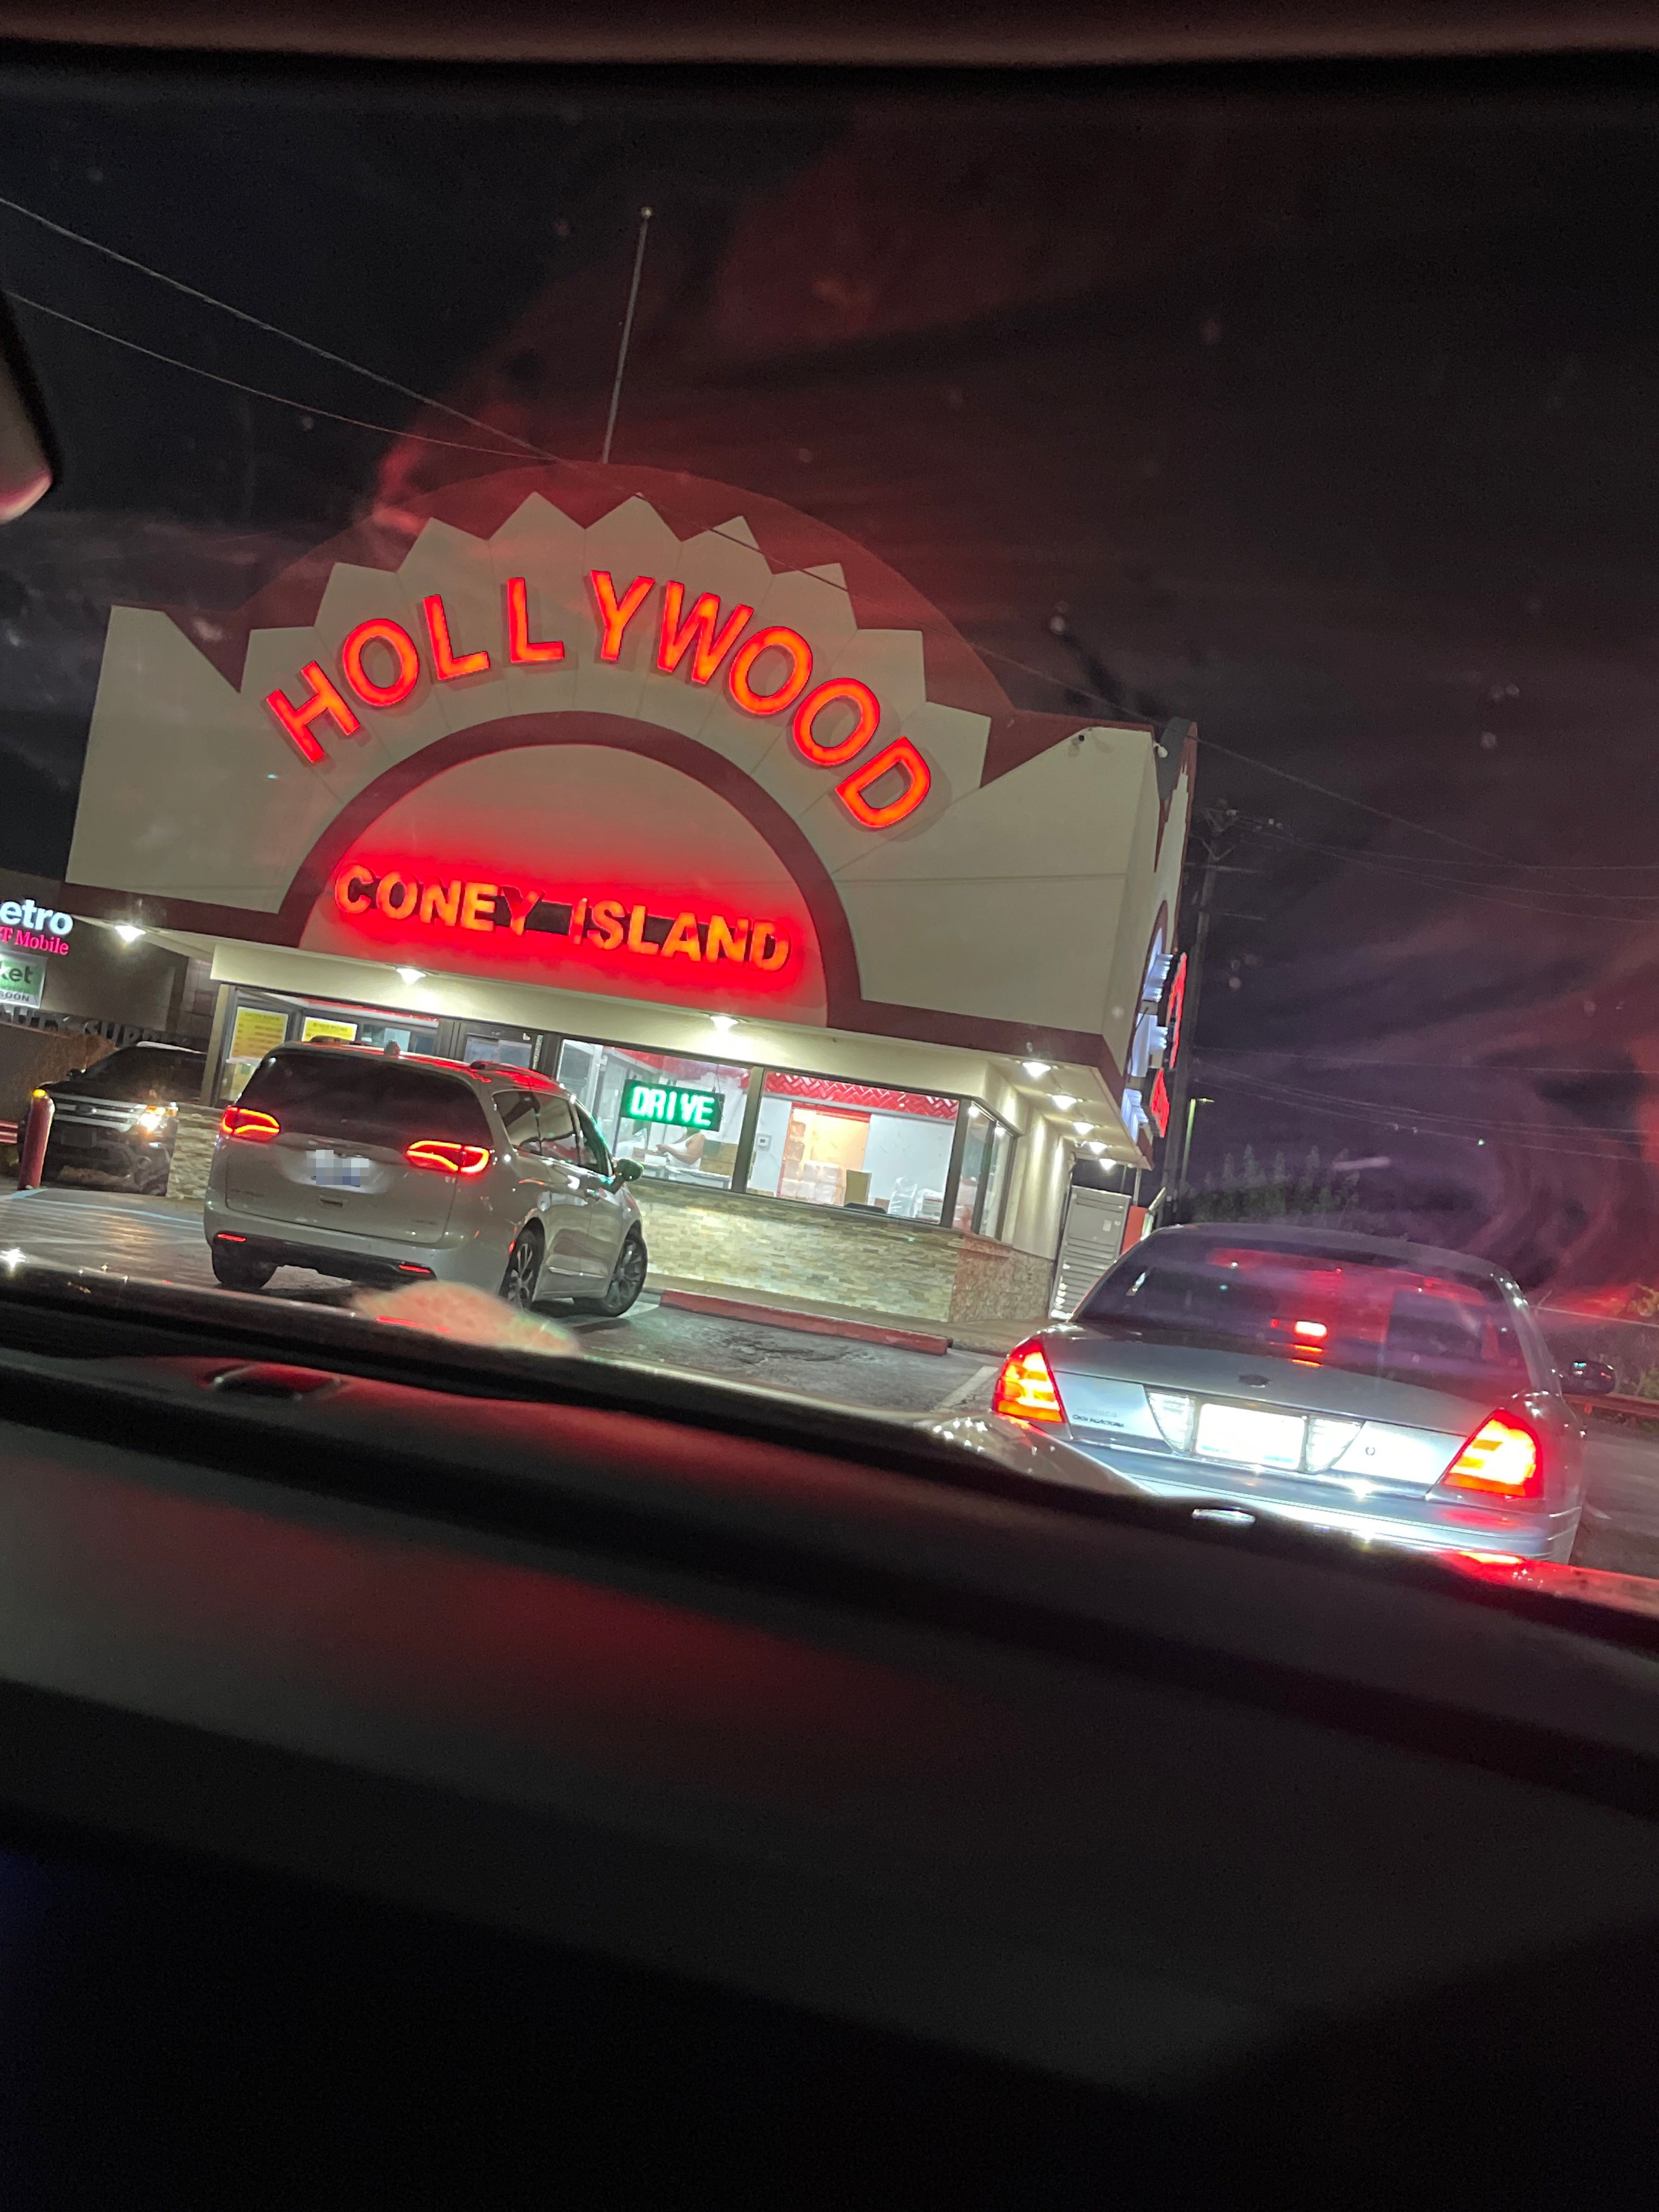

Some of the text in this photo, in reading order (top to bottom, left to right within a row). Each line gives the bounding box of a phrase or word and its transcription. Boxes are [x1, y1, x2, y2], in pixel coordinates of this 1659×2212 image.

[266, 569, 931, 828] HOLLYWOOD
[15, 929, 70, 956] Mobile
[334, 865, 791, 971] CONEY ISLAND
[631, 1086, 715, 1126] DRIVE
